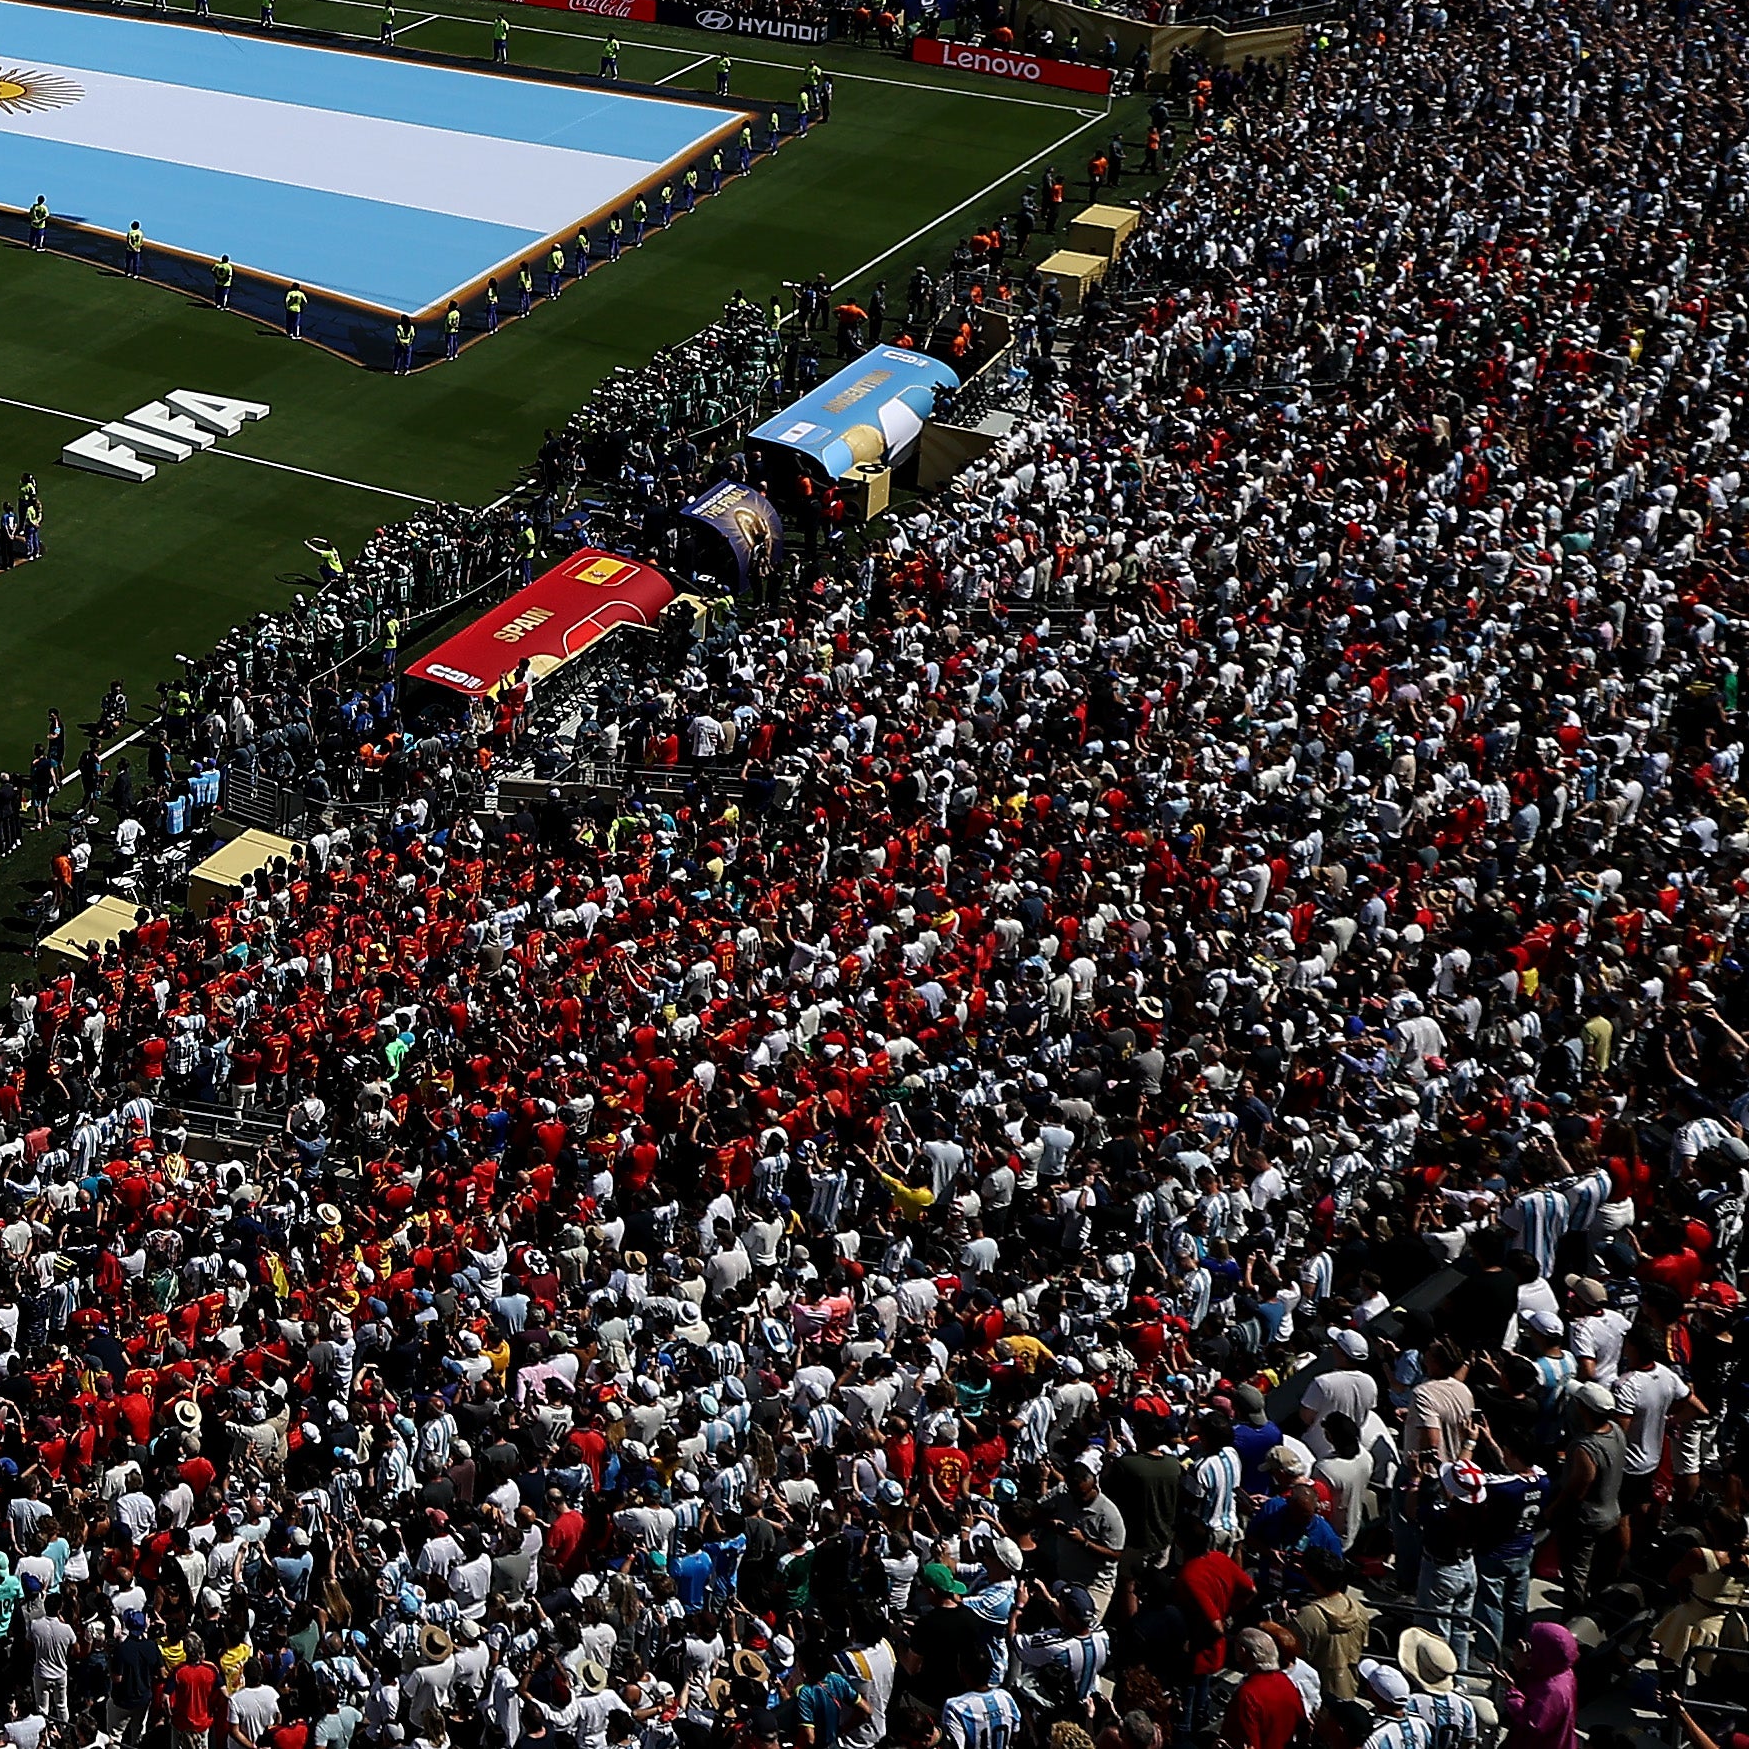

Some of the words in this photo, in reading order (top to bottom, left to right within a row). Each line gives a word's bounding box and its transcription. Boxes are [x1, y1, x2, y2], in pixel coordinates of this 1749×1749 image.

[941, 44, 1042, 81] Lenovo
[60, 387, 271, 483] FIFA
[492, 605, 556, 644] SPAIN
